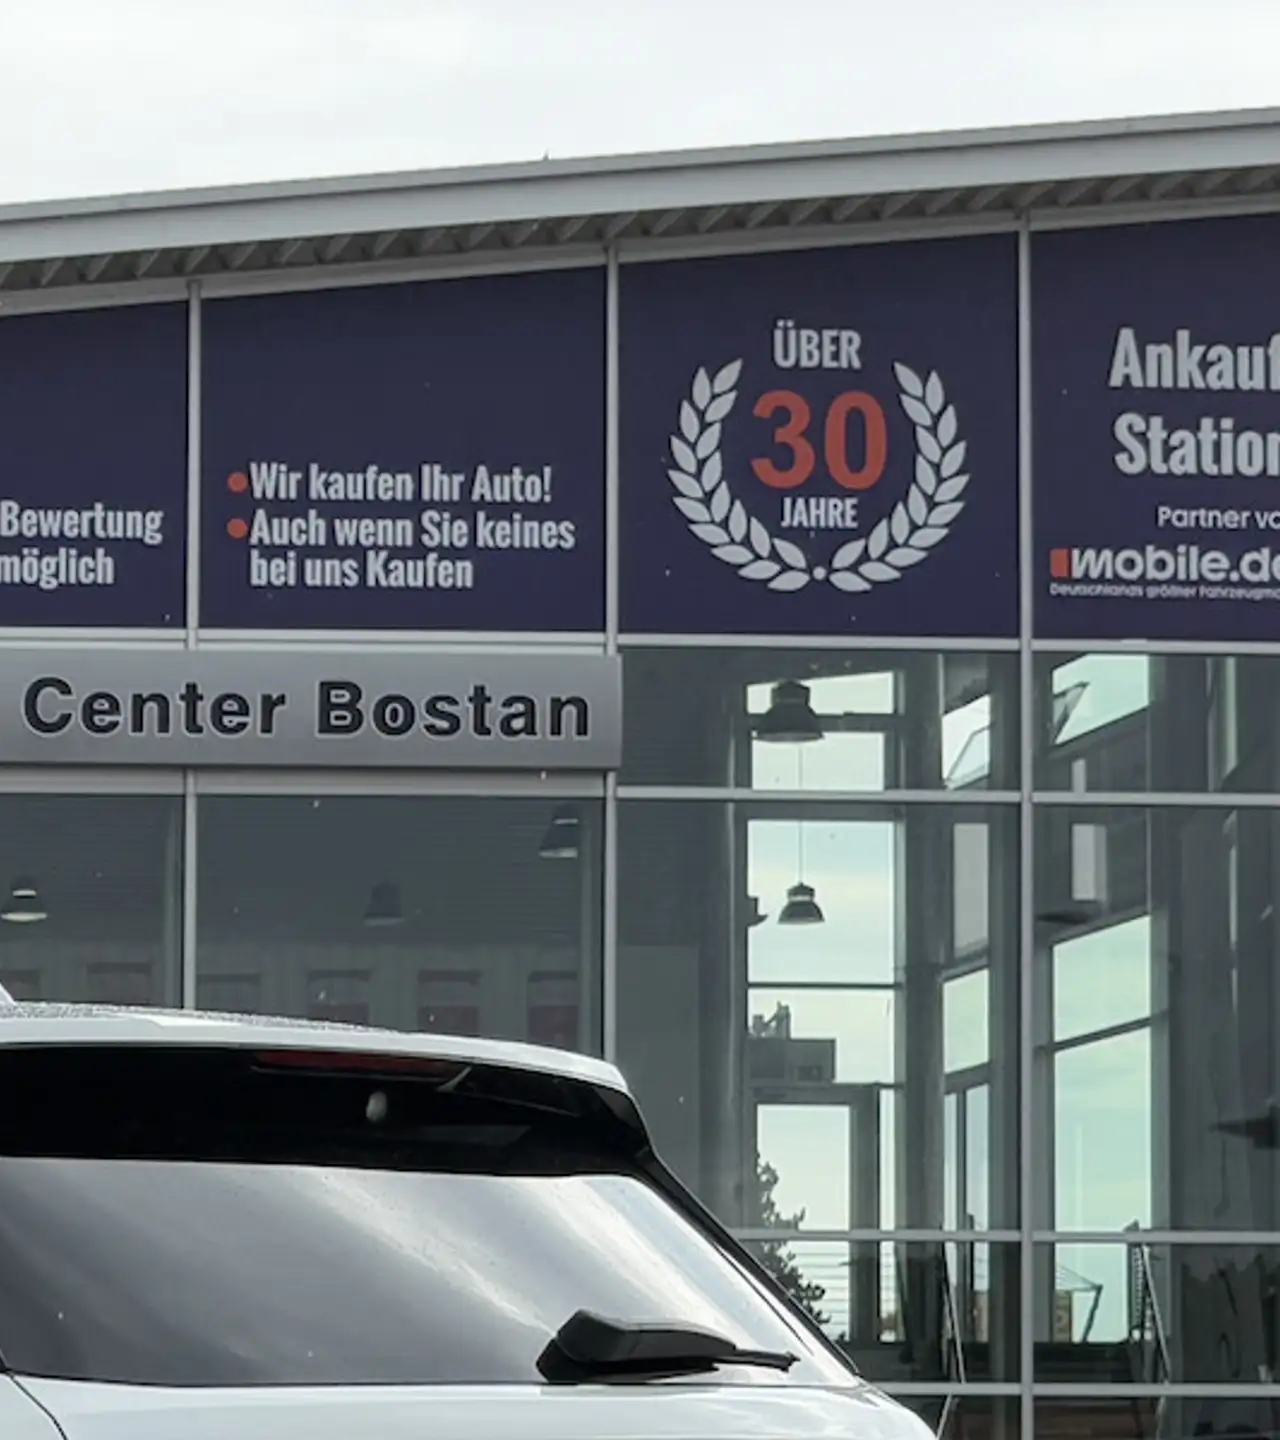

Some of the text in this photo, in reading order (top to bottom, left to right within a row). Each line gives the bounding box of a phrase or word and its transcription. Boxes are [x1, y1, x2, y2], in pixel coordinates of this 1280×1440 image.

[773, 319, 862, 370] ÜBER
[750, 389, 889, 490] 30
[250, 461, 552, 503] Wir kaufen Ihr Auto!
[0, 501, 164, 545] Bewertung
[249, 508, 576, 550] Auch wenn Sie keines
[780, 496, 859, 529] JAHRE
[1157, 505, 1250, 529] Partner
[250, 549, 474, 589] bei uns Kaufen
[22, 675, 287, 737] Center
[315, 679, 591, 739] Bostan
